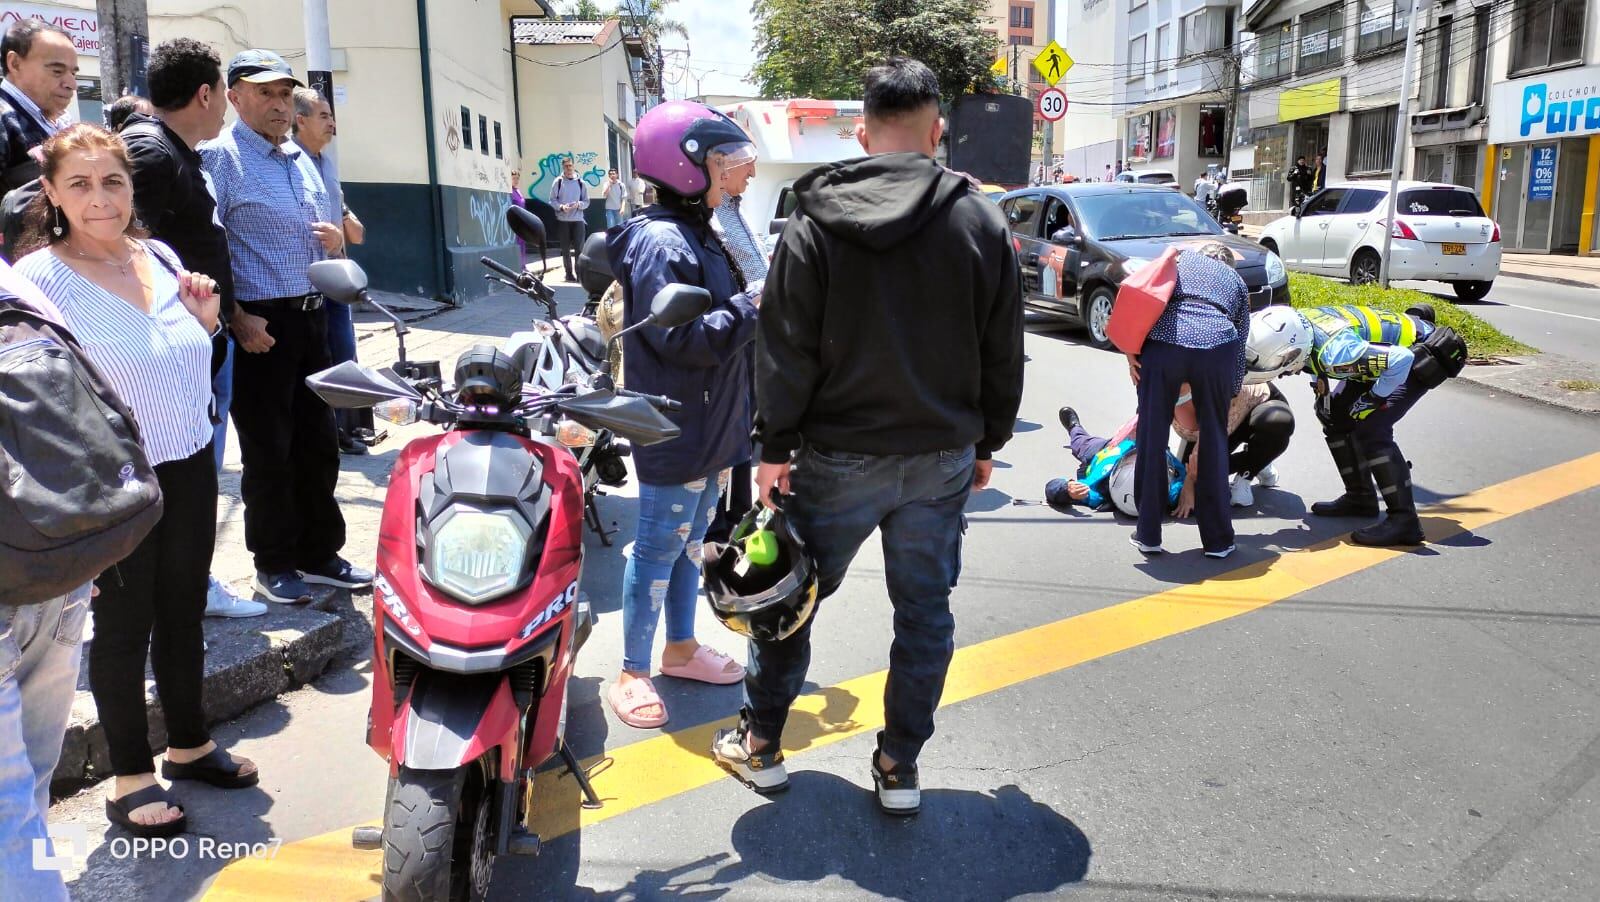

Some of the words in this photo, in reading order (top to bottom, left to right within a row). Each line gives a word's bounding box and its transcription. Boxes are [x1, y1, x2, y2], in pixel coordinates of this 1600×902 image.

[1548, 85, 1597, 101] COLCHON
[1043, 96, 1062, 113] 30
[1520, 82, 1600, 137] Para
[1541, 147, 1551, 160] 12
[1535, 167, 1553, 179] 0%
[520, 580, 578, 640] PRO
